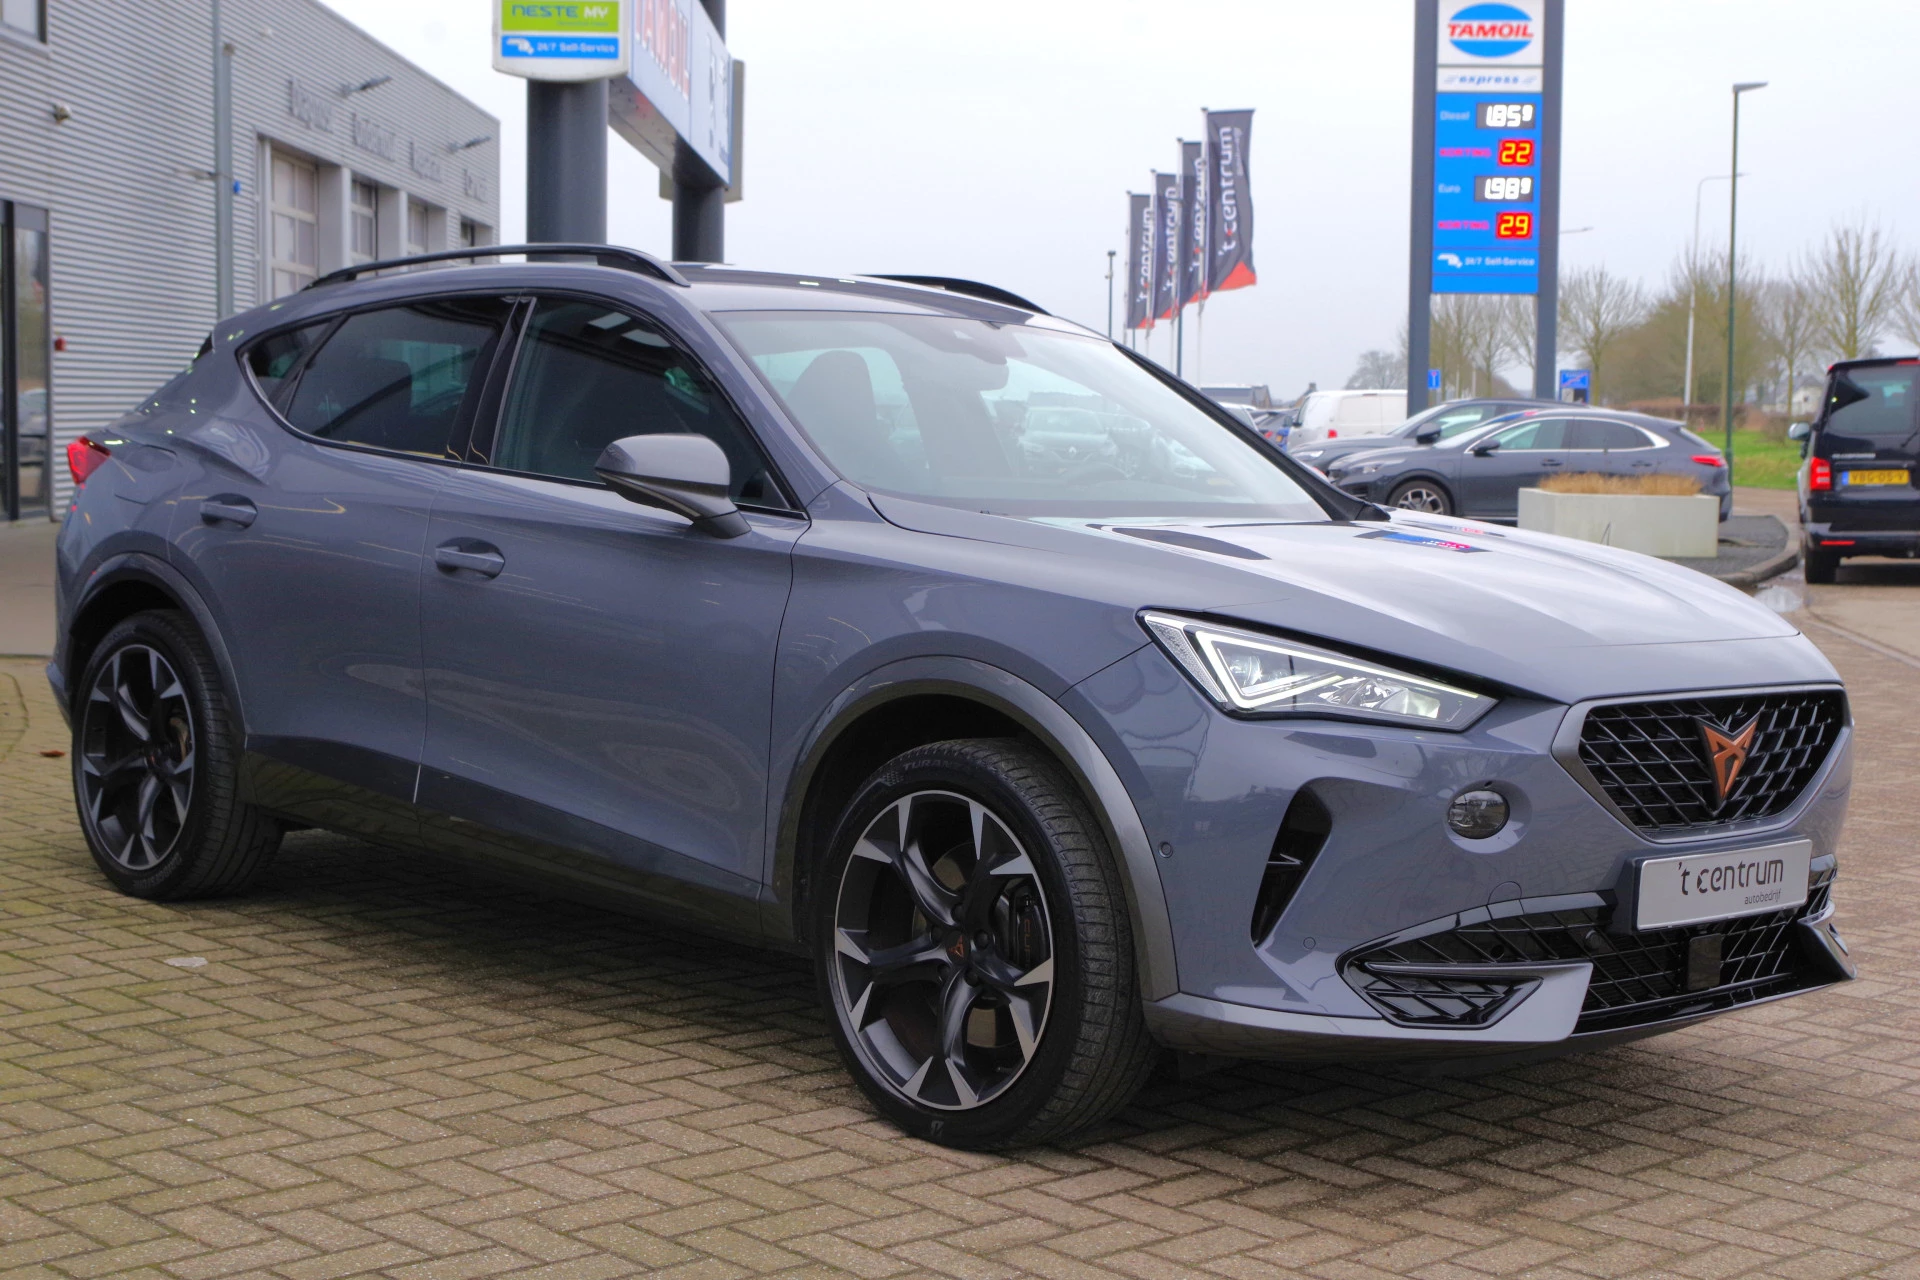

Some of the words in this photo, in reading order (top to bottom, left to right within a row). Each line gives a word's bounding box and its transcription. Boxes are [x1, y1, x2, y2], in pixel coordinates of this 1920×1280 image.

[584, 6, 609, 18] MY
[1447, 23, 1534, 39] TAMOIL
[1459, 75, 1520, 85] express
[1440, 110, 1470, 120] Diesel
[1501, 142, 1531, 163] 22
[1219, 126, 1238, 236] centrum
[1438, 184, 1461, 193] Euro
[1500, 215, 1529, 235] 29
[1677, 861, 1690, 895] 't
[1697, 859, 1784, 894] centrum
[1744, 890, 1782, 905] autobedrijf
